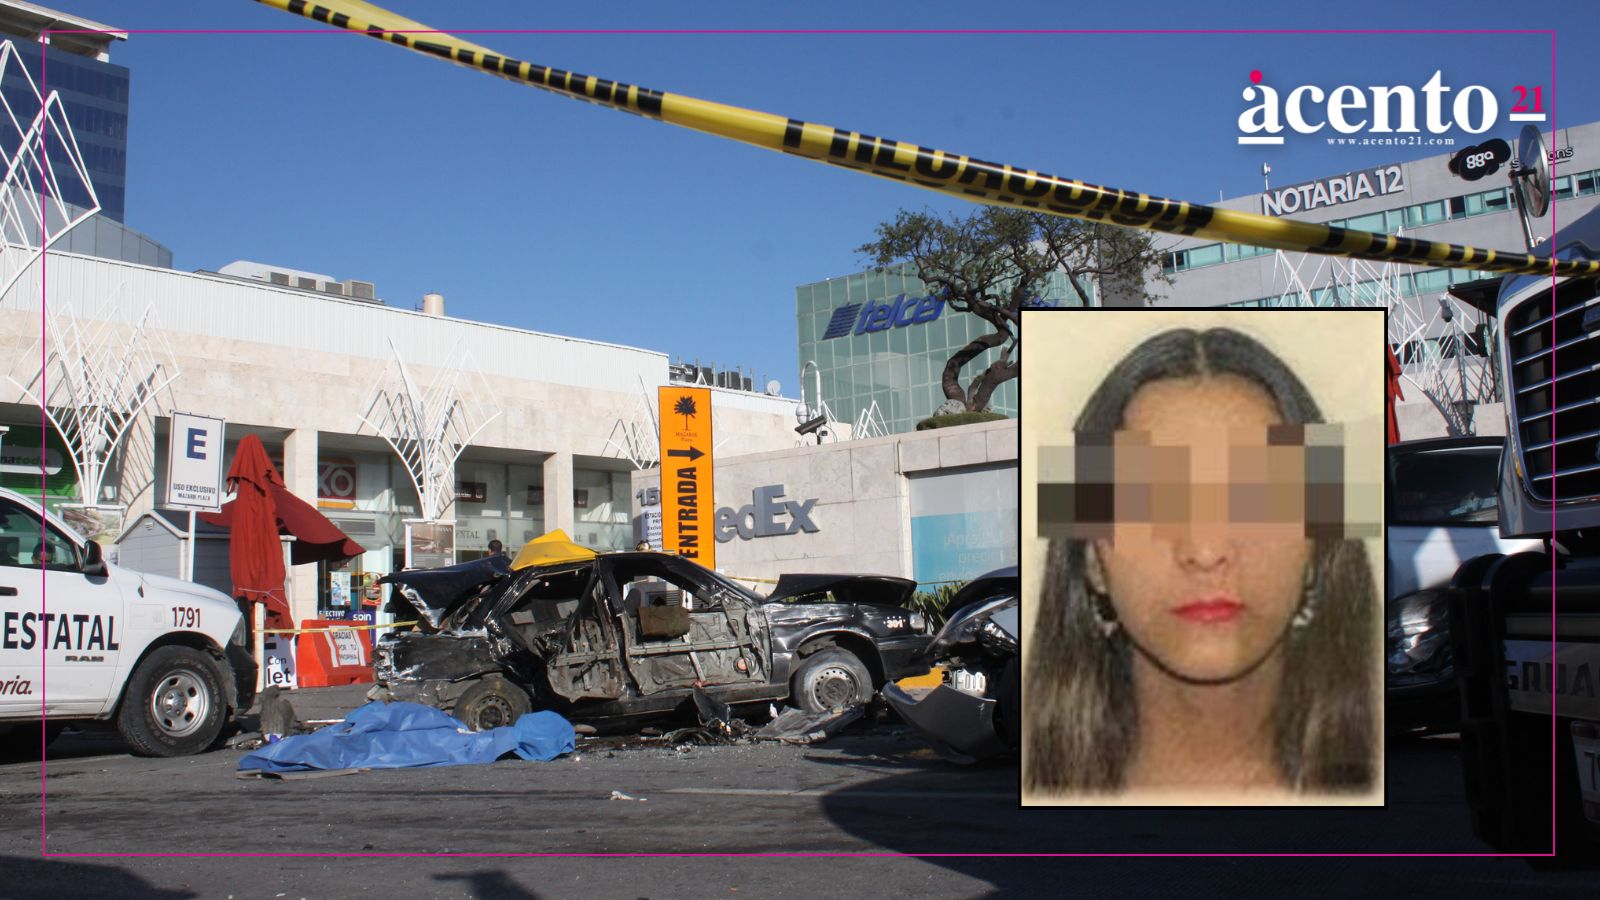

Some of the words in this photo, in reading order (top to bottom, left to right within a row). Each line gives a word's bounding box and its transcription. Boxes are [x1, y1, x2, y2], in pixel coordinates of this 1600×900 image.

[1466, 151, 1495, 169] gga
[1262, 171, 1375, 216] NOTARÍA
[1375, 165, 1405, 194] 12
[853, 286, 949, 336] telcel
[186, 427, 207, 460] E
[173, 483, 185, 491] USO
[186, 484, 216, 494] EXCLUSIVO
[677, 466, 698, 559] ENTRADA
[715, 484, 820, 543] edEx
[3, 611, 119, 651] ESTATAL
[171, 606, 201, 629] 1791
[65, 655, 104, 663] RAM
[267, 655, 287, 665] Con
[0, 674, 33, 696] ria.
[1505, 659, 1600, 698] GRUA
